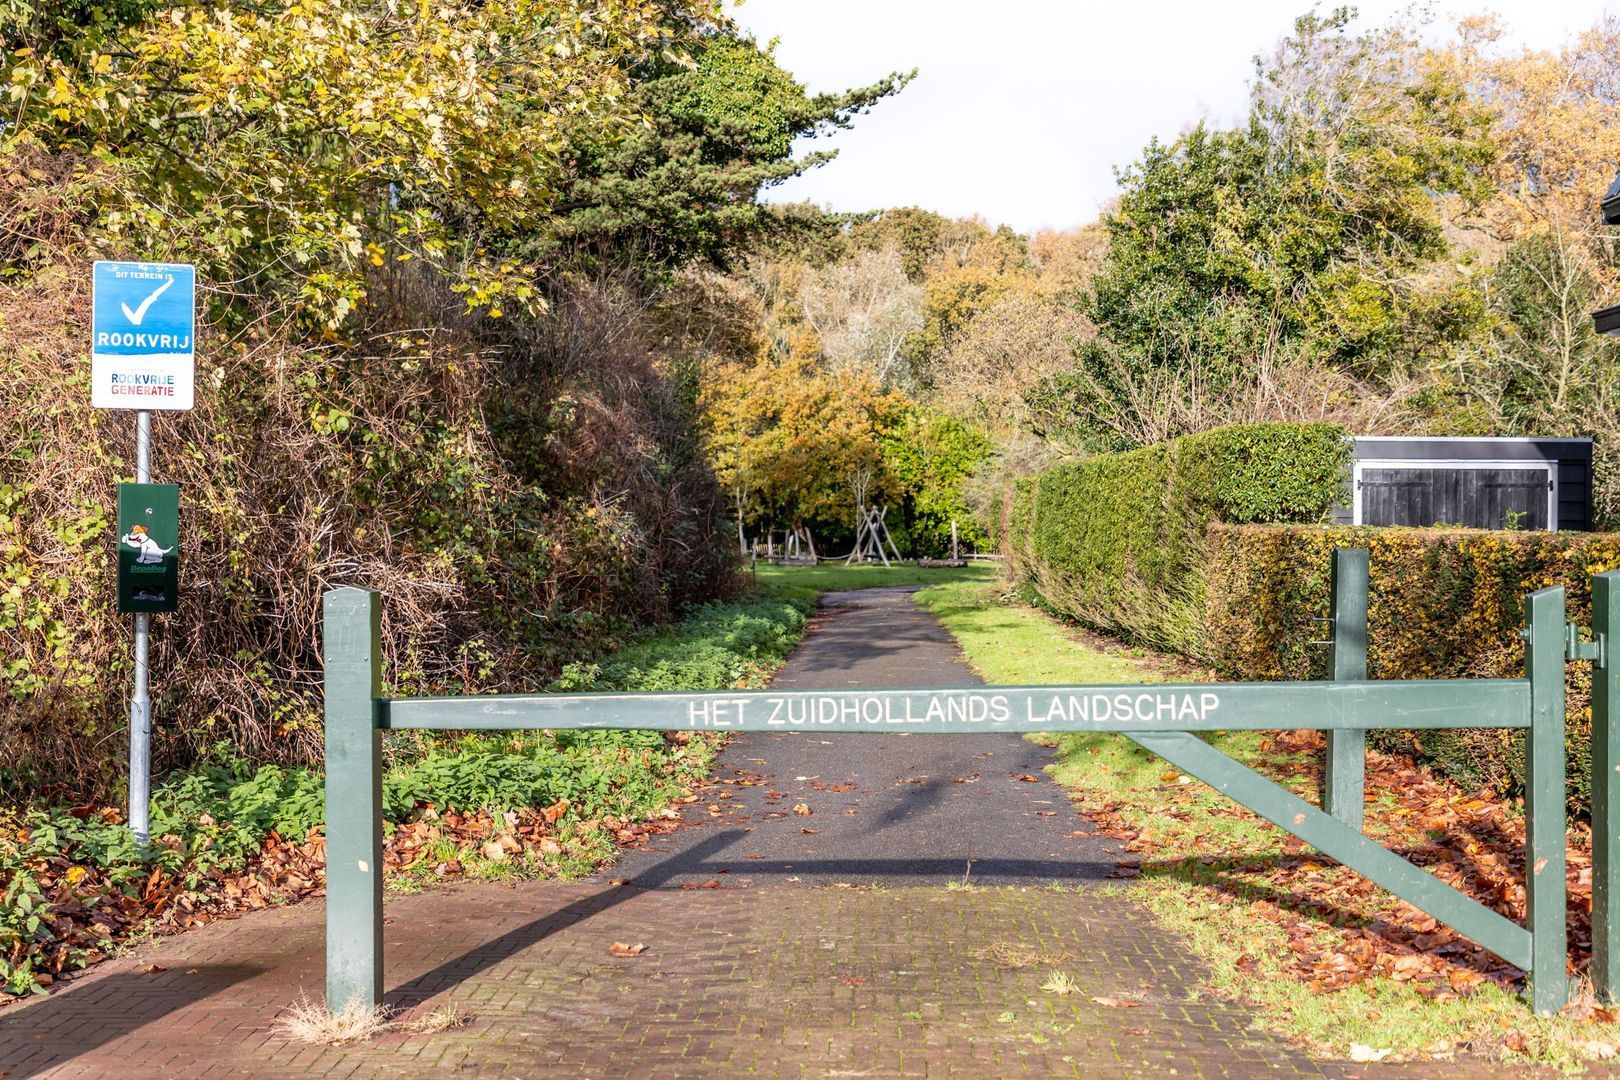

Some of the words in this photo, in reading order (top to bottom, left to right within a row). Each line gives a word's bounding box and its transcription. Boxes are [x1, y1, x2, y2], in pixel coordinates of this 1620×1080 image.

[130, 272, 163, 280] TERREIN
[97, 332, 189, 349] ROOKVRIJ
[111, 373, 175, 385] ROOKVRIJE
[111, 385, 175, 397] GENERATIE
[689, 699, 751, 726] HET
[767, 696, 1011, 725] ZUIDHOLLANDS
[1027, 693, 1220, 721] LANDSCHAP
